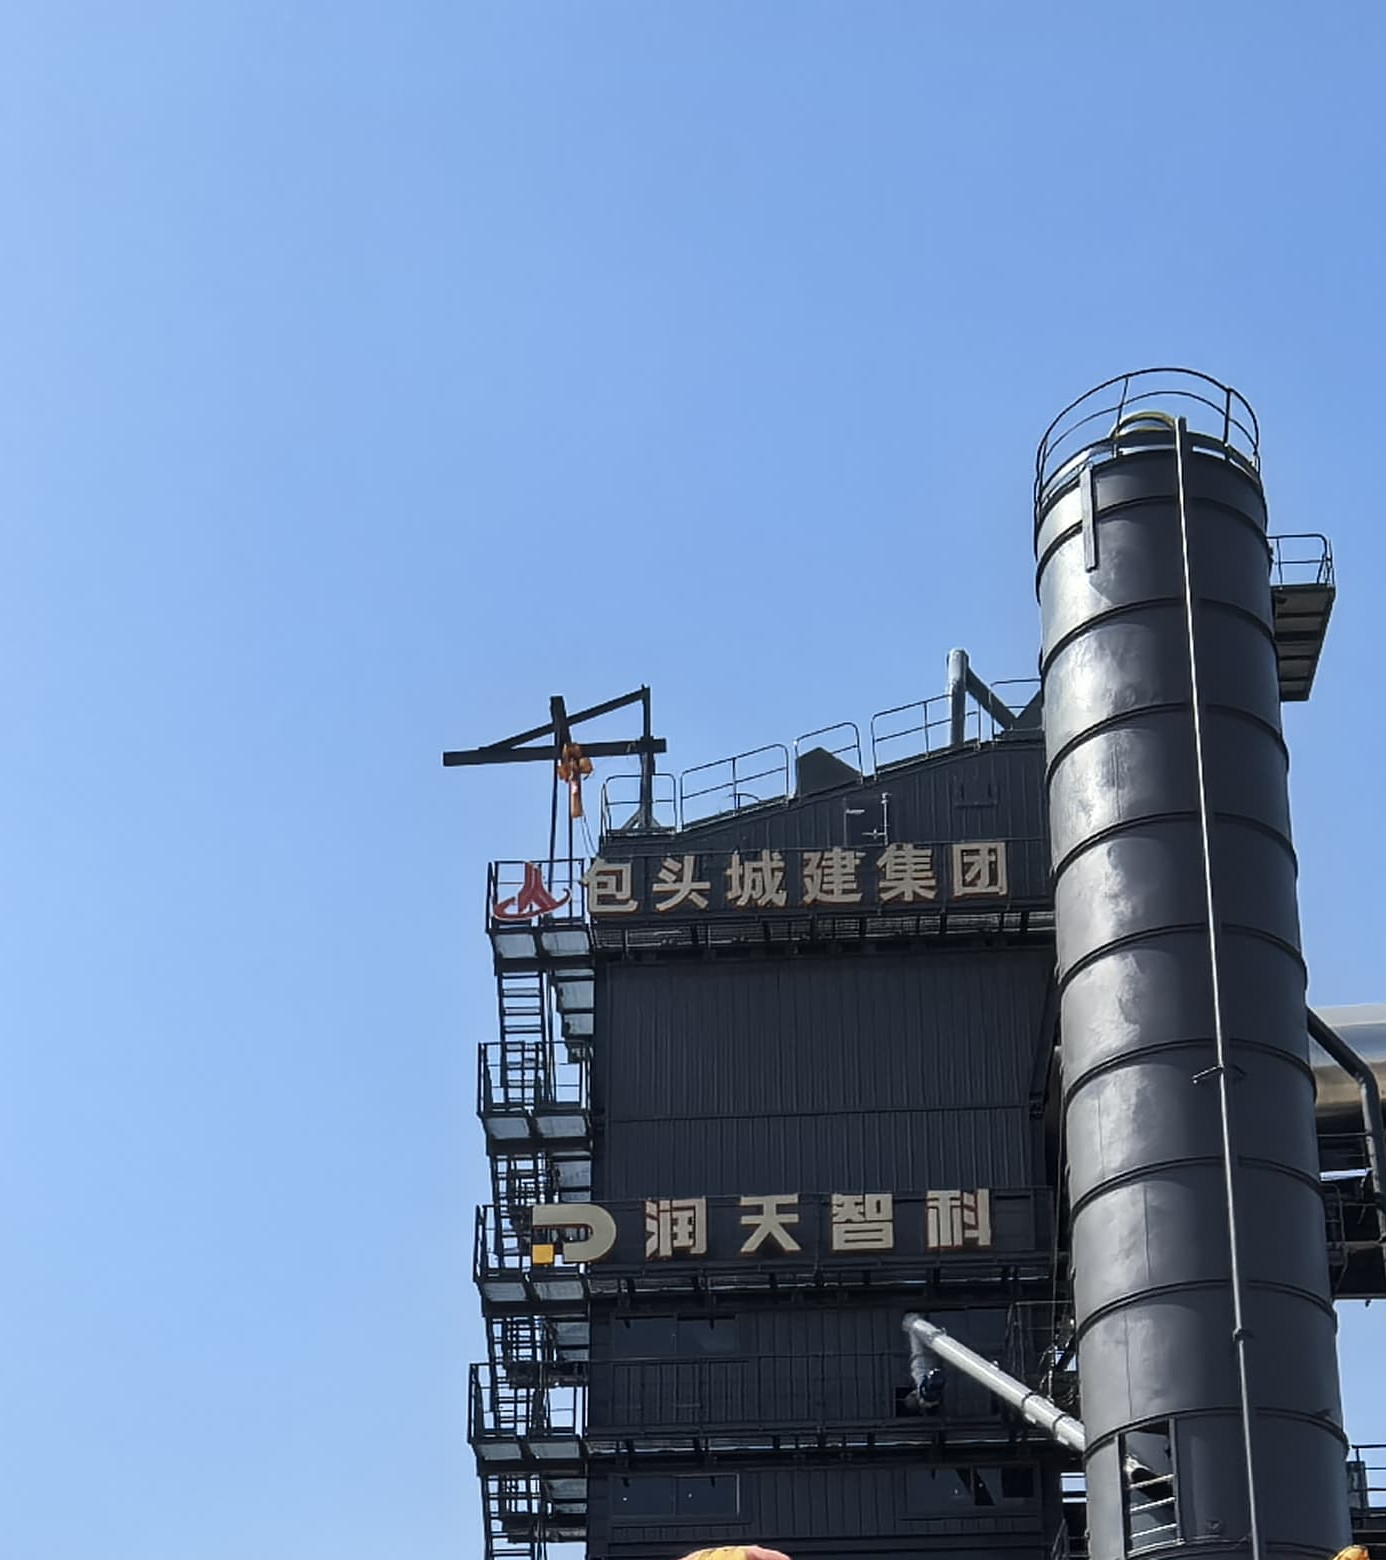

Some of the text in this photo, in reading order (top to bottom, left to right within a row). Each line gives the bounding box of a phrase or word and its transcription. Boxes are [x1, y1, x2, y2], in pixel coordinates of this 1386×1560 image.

[583, 842, 1008, 914] 包头城建集团
[645, 1188, 992, 1257] 润天智科
